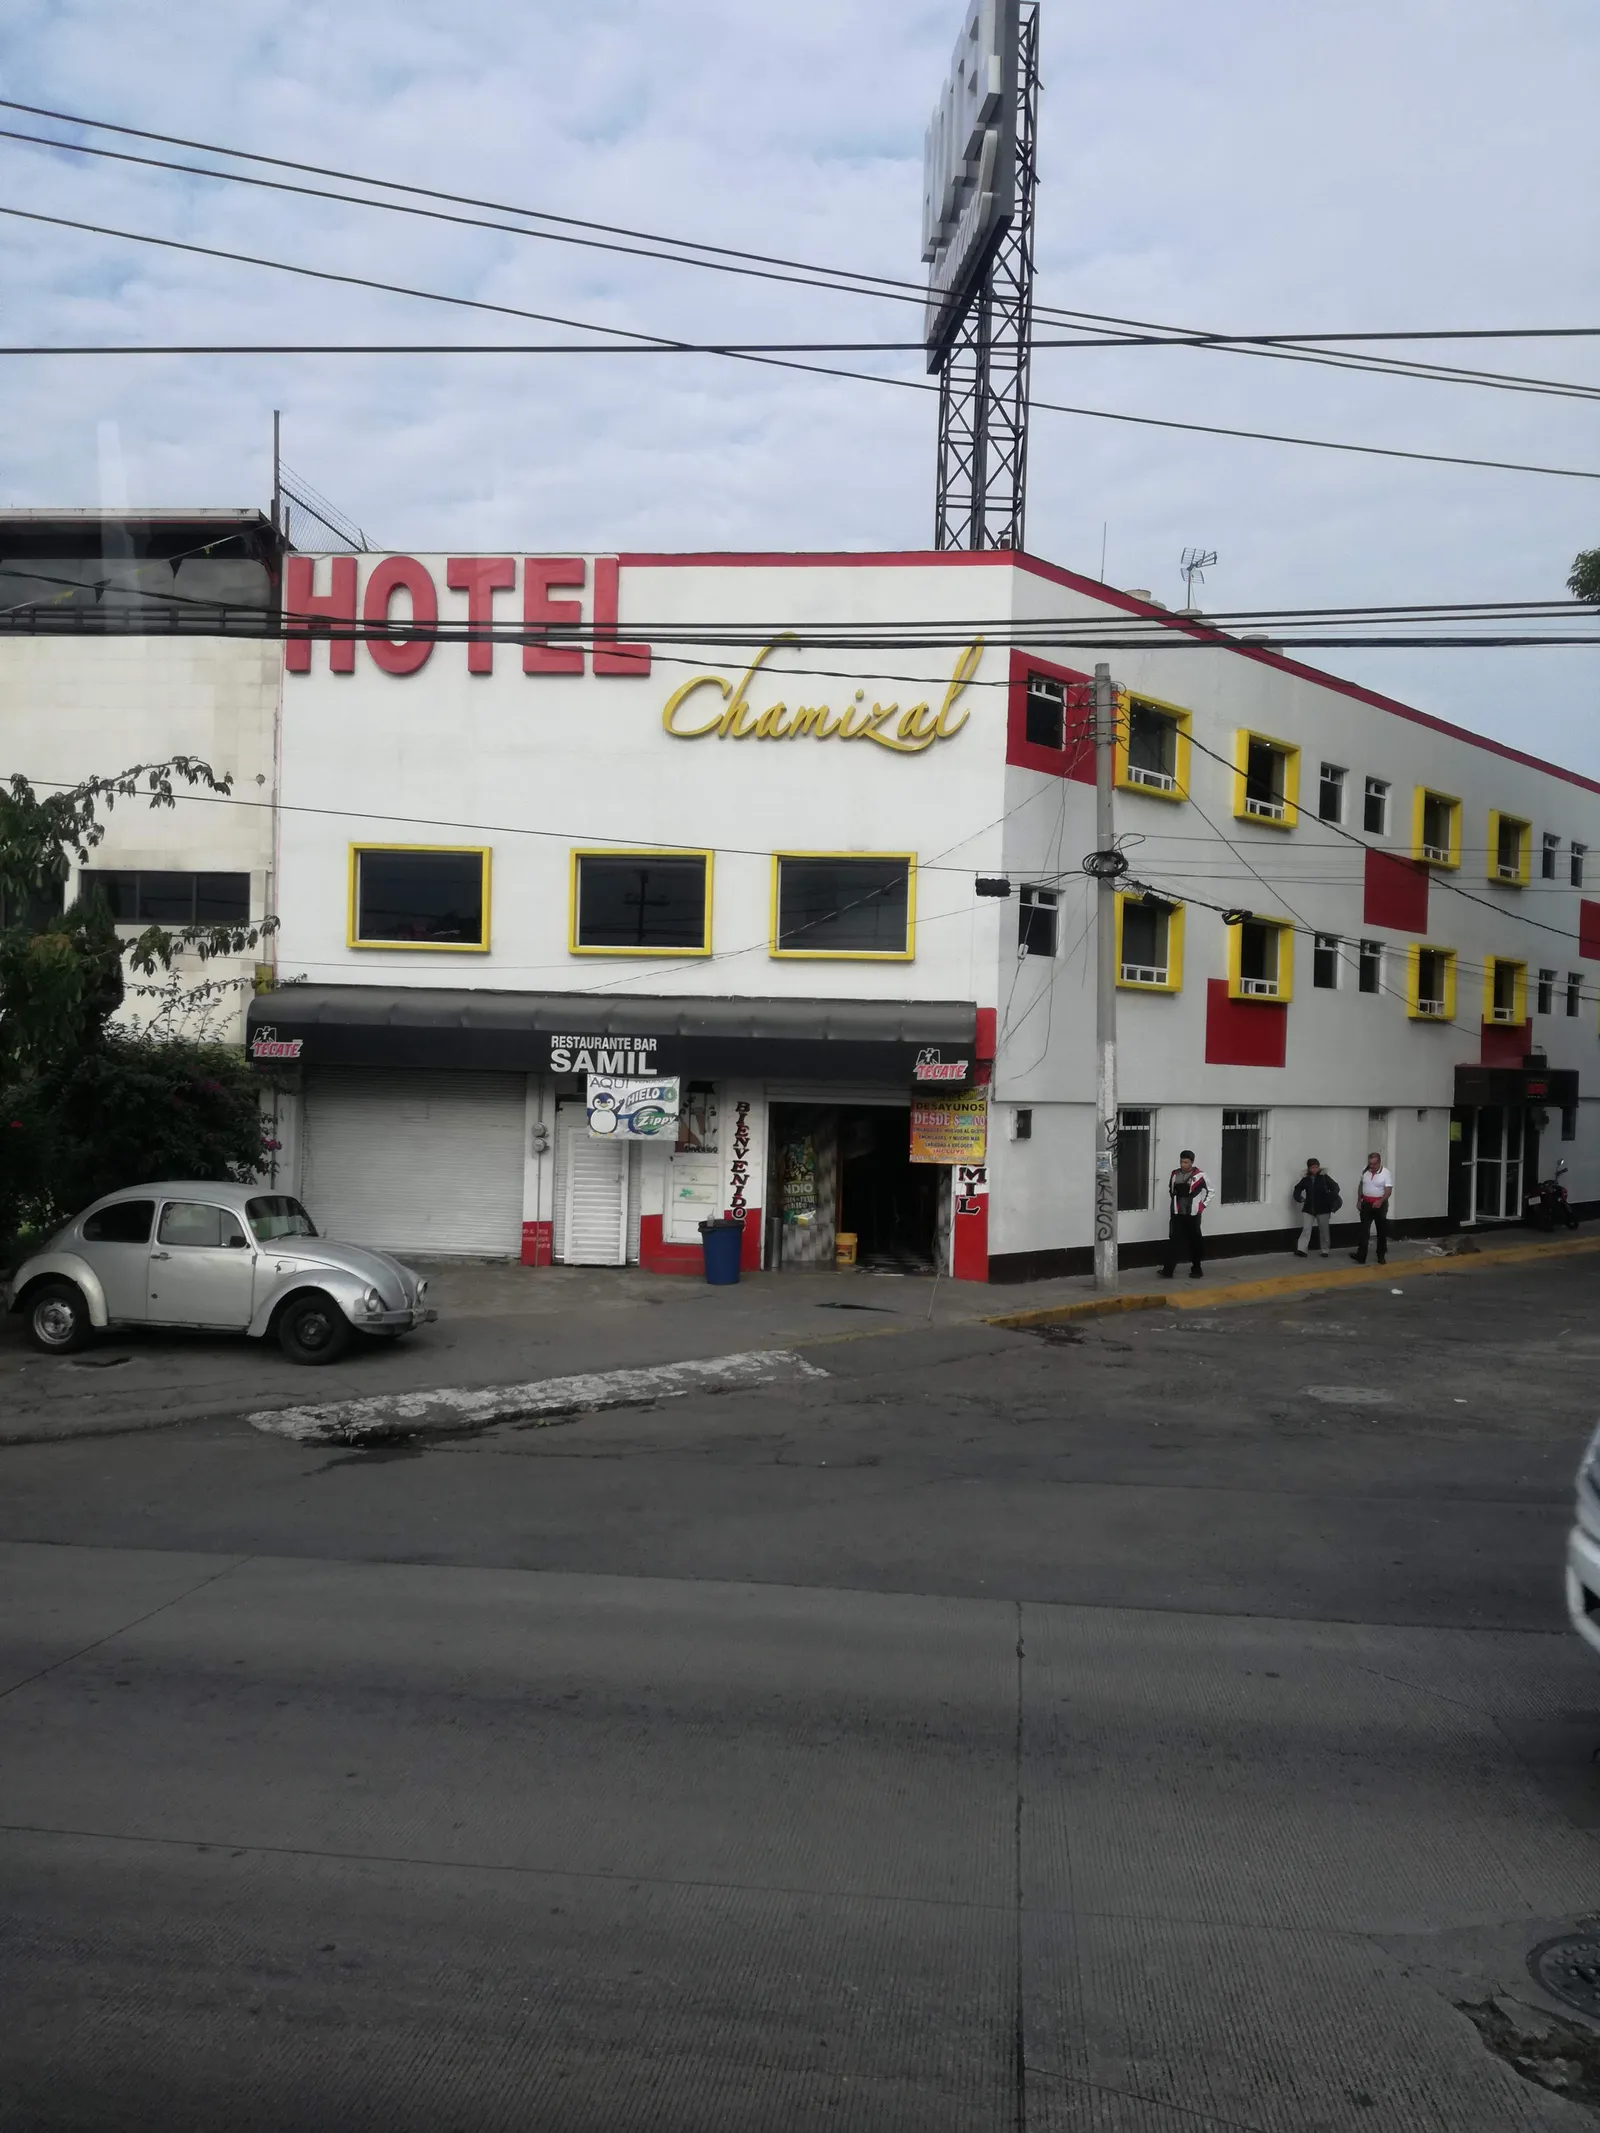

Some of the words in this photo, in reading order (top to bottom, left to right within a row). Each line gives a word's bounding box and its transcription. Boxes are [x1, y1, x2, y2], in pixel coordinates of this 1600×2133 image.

[285, 555, 652, 677] HOTEL
[661, 631, 986, 753] Chamizal
[251, 1042, 302, 1057] TECATE
[551, 1035, 631, 1050] RESTAURANTE
[633, 1038, 657, 1051] BAR
[550, 1048, 658, 1075] SAMIL
[914, 1064, 968, 1080] TECATE
[590, 1077, 629, 1089] AQUI
[627, 1087, 660, 1106] HIELO
[916, 1103, 985, 1112] DESAYUNOS
[636, 1115, 676, 1127] Zippy
[913, 1112, 950, 1126] DESDE
[729, 1101, 750, 1220] BIENVENIDO
[783, 1183, 813, 1194] NDIO
[958, 1166, 987, 1215] MIL
